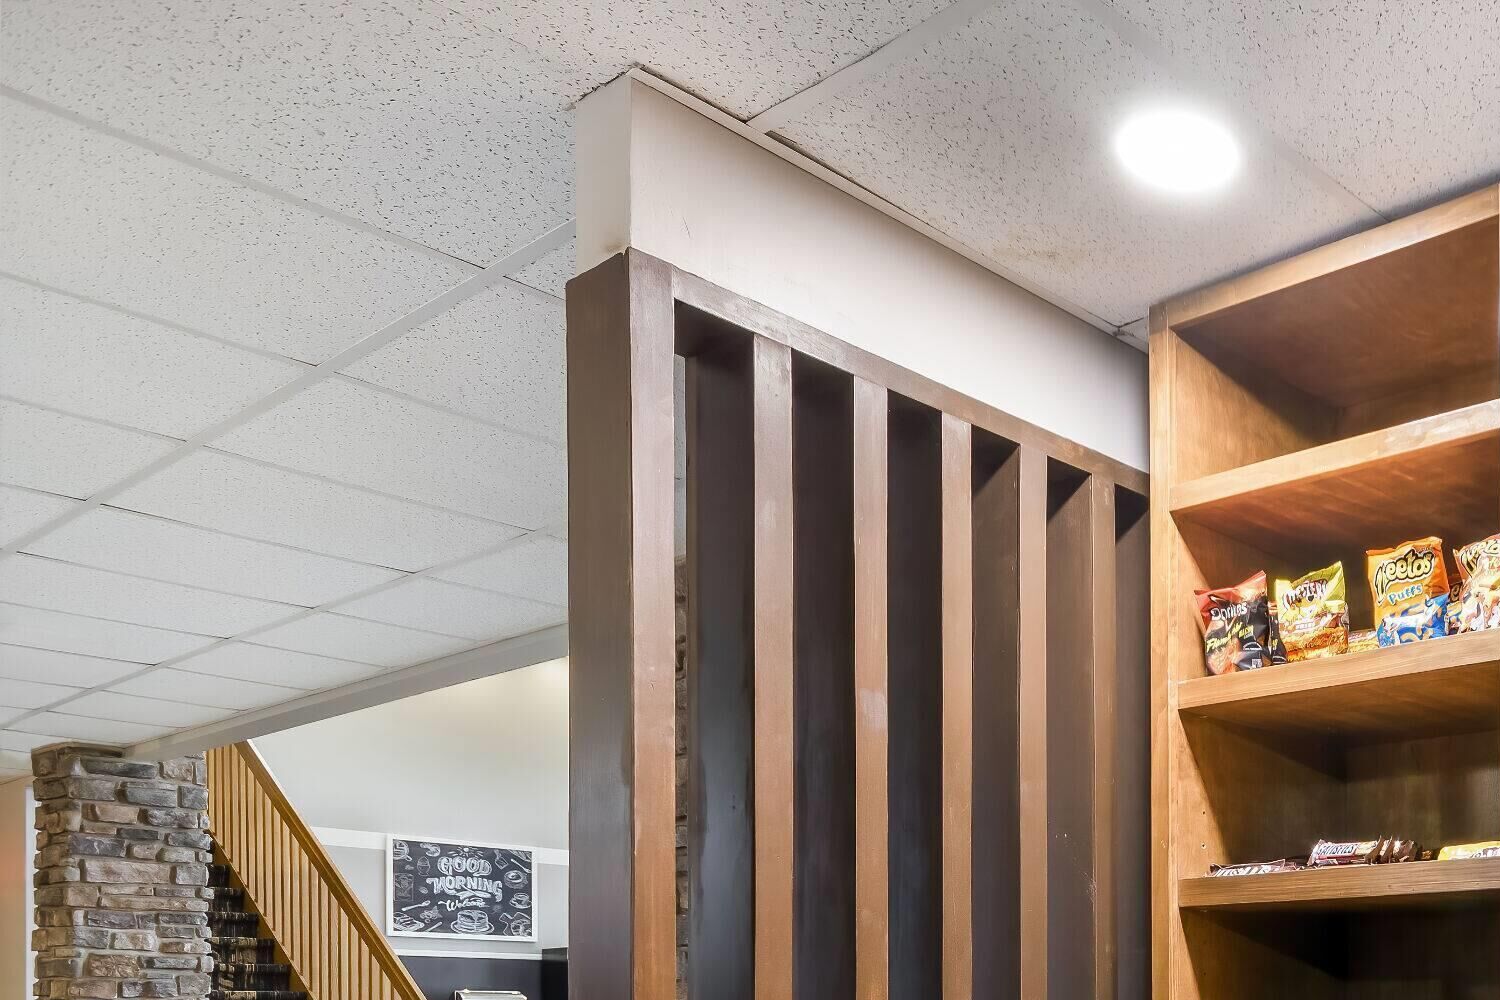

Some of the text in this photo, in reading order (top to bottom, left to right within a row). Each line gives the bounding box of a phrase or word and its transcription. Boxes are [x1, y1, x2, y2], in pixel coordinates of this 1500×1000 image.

[1210, 601, 1248, 620] Doritos
[437, 856, 492, 876] GOOD
[426, 876, 502, 902] MORNING
